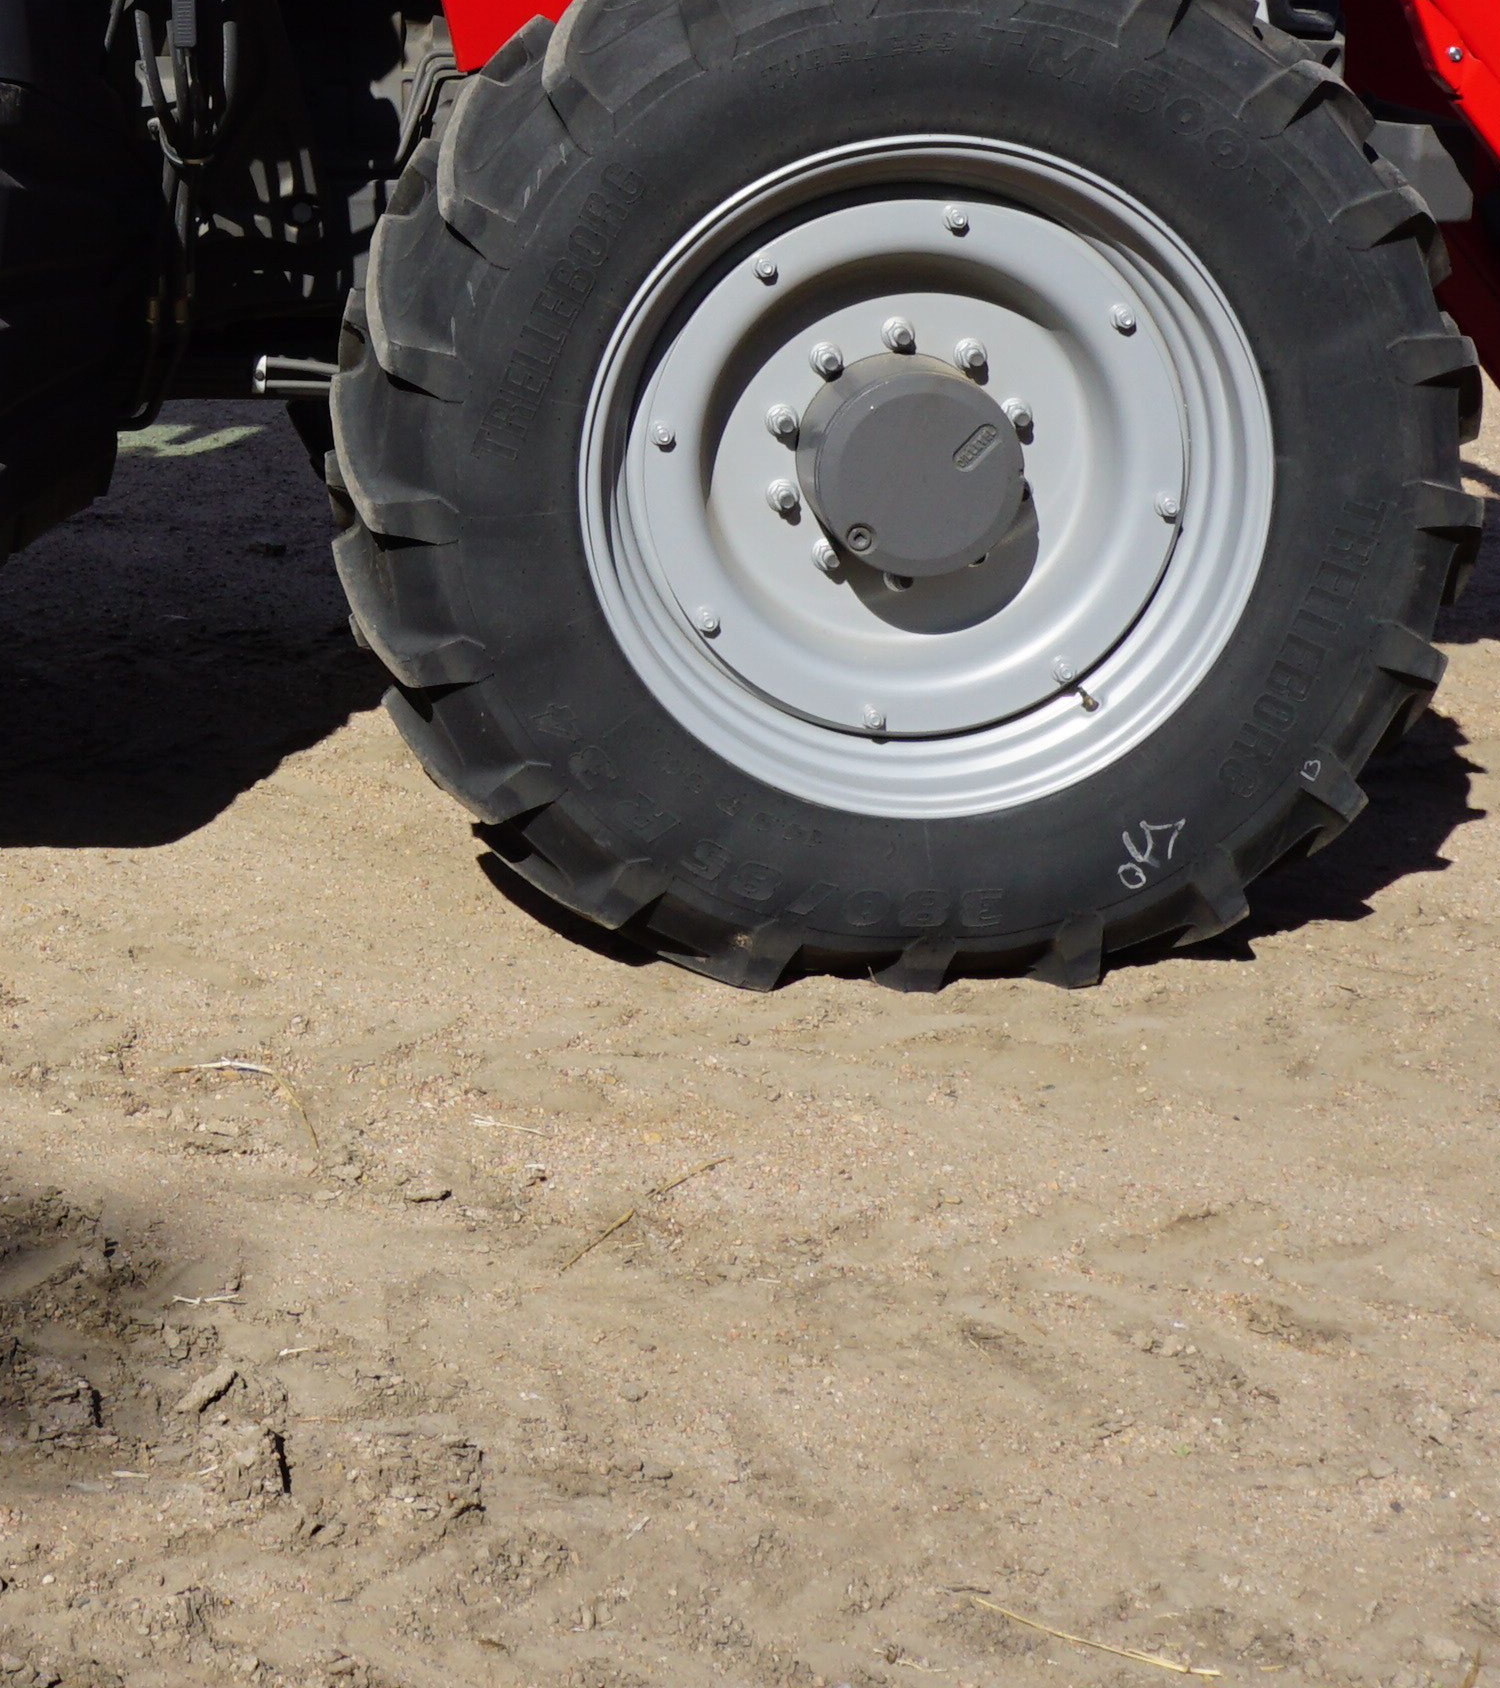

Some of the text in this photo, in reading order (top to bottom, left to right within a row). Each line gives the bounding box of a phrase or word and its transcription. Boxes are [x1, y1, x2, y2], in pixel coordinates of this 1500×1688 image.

[758, 28, 958, 90] TUBELESS
[470, 159, 648, 463] TRELLEBORG
[1217, 499, 1387, 800] TRELLEBORG
[680, 839, 1003, 928] 380/85
